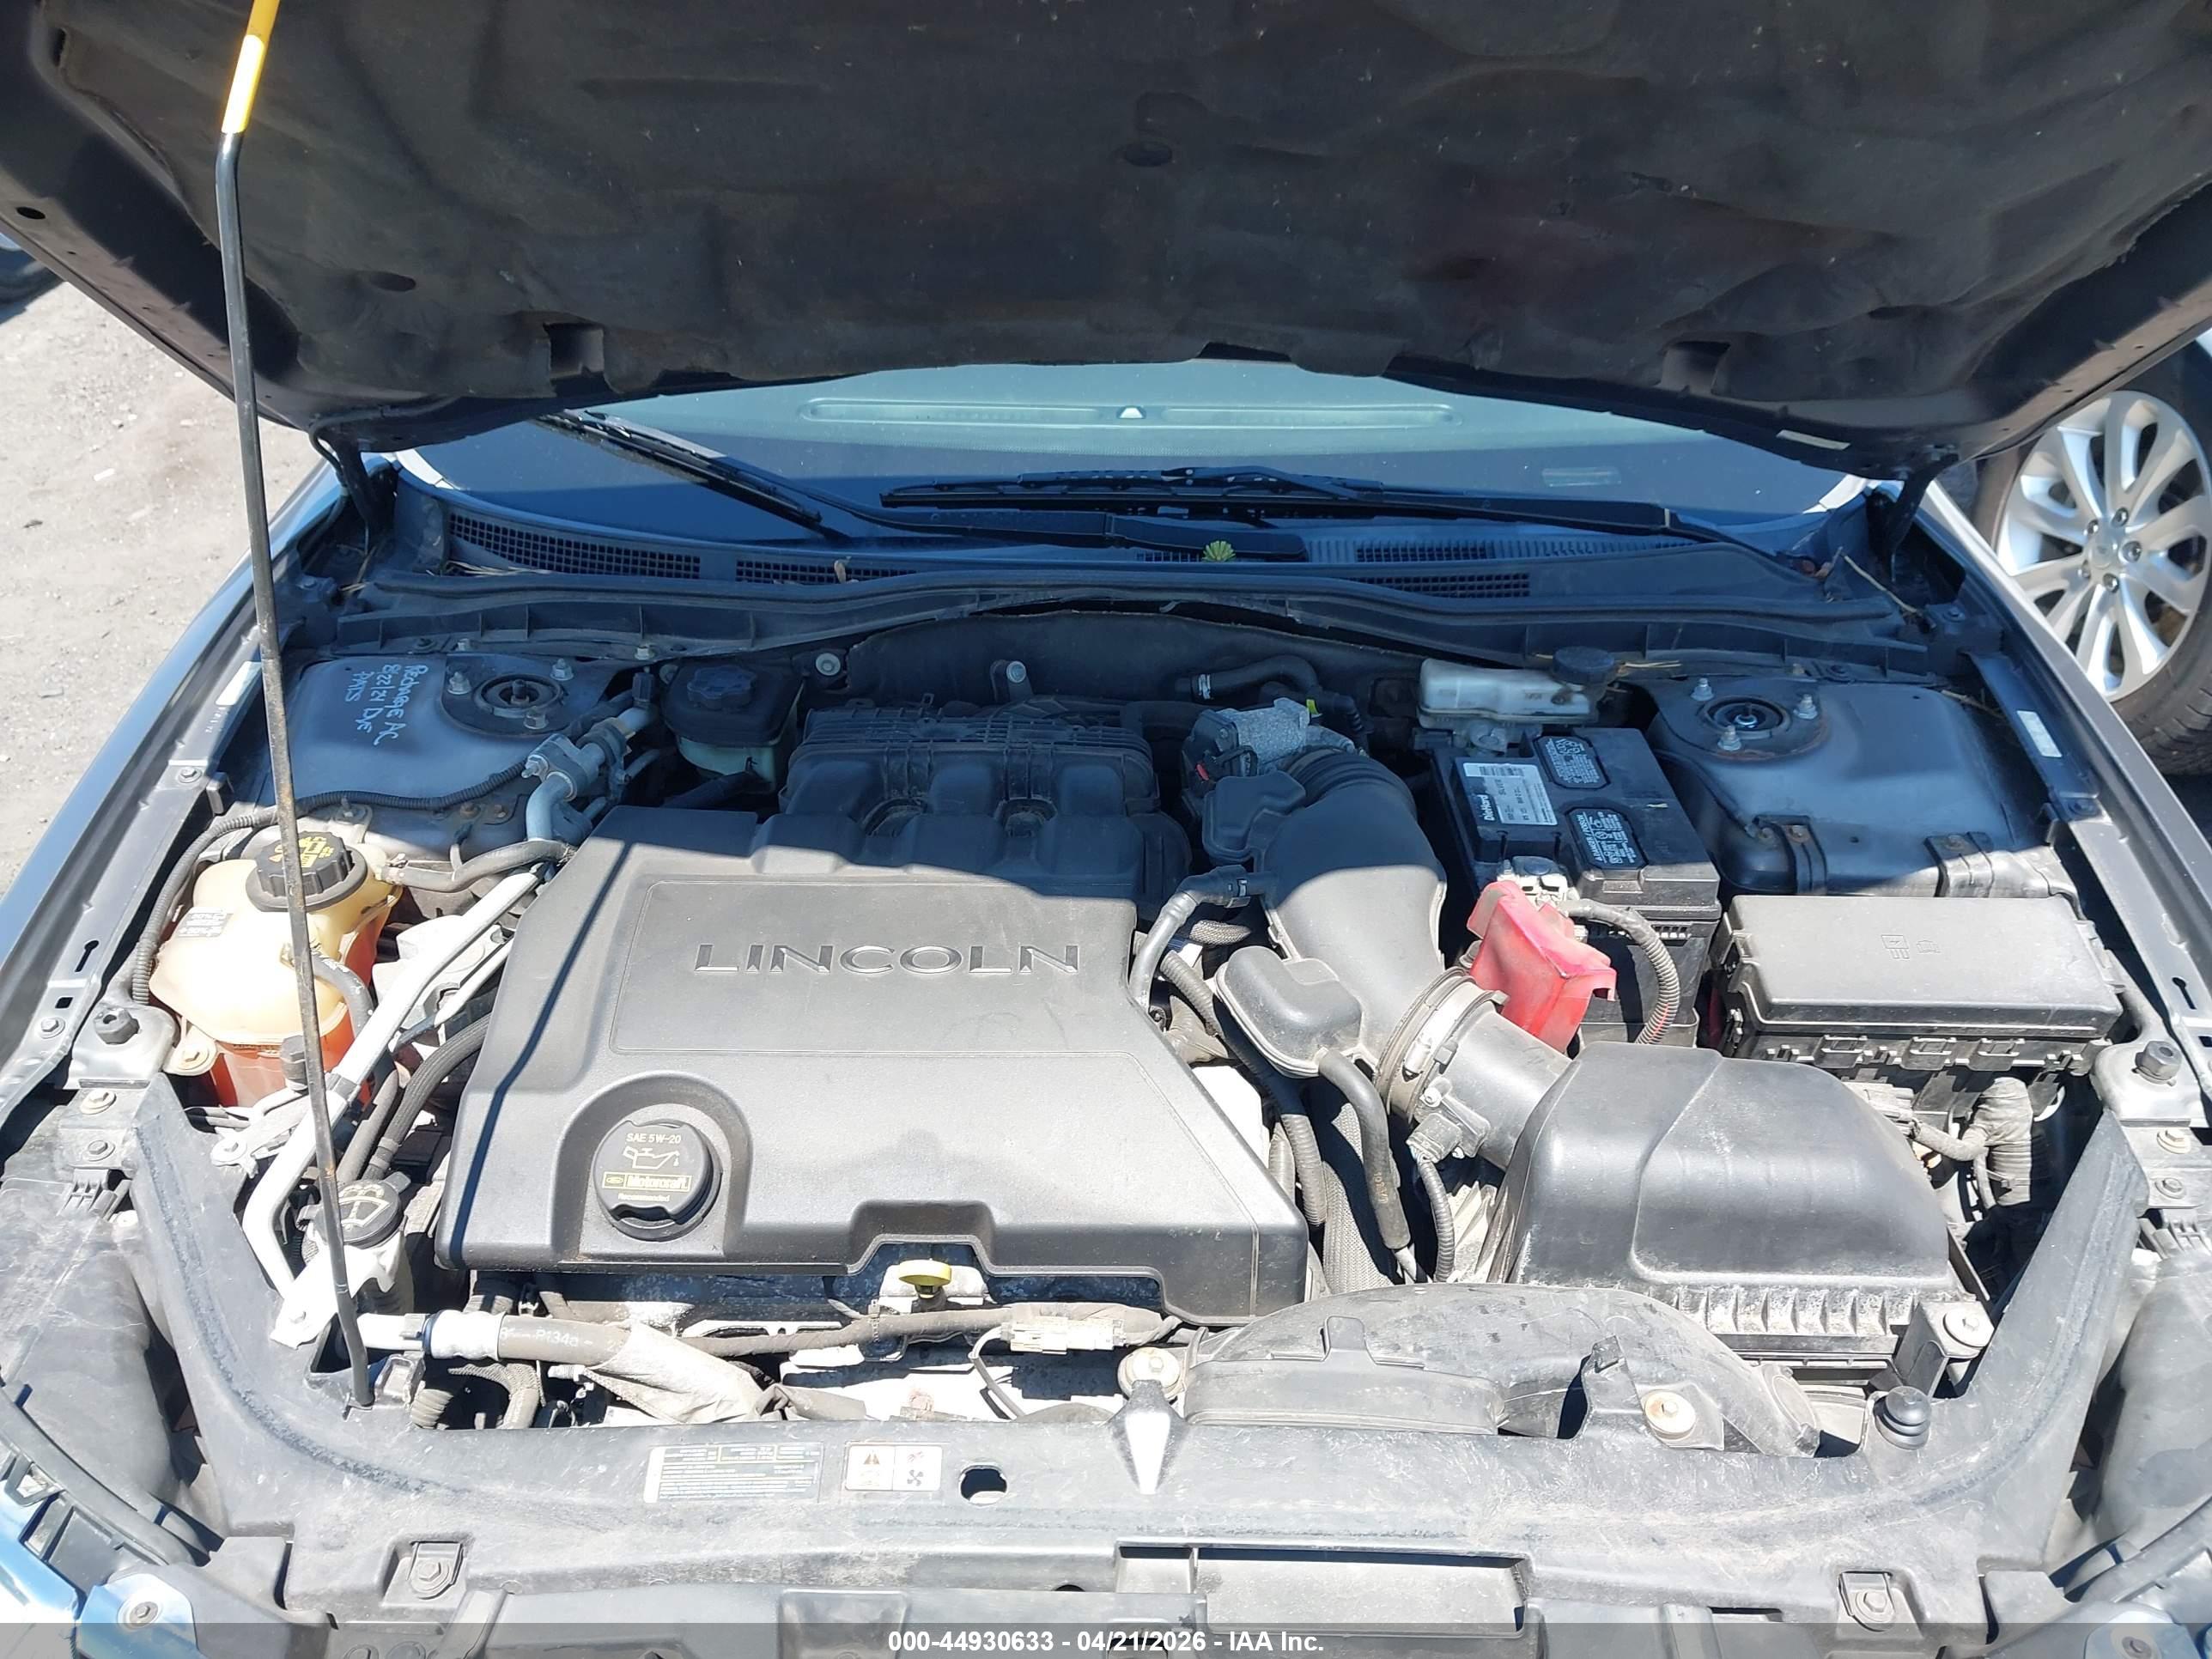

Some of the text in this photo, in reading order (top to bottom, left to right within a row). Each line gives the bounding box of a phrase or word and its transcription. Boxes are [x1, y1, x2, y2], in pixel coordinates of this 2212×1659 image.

[374, 721, 407, 746] AC
[1477, 794, 1495, 821] DieHard
[694, 944, 1079, 974] LINCOLN
[626, 1133, 682, 1144] SAE 5W-20
